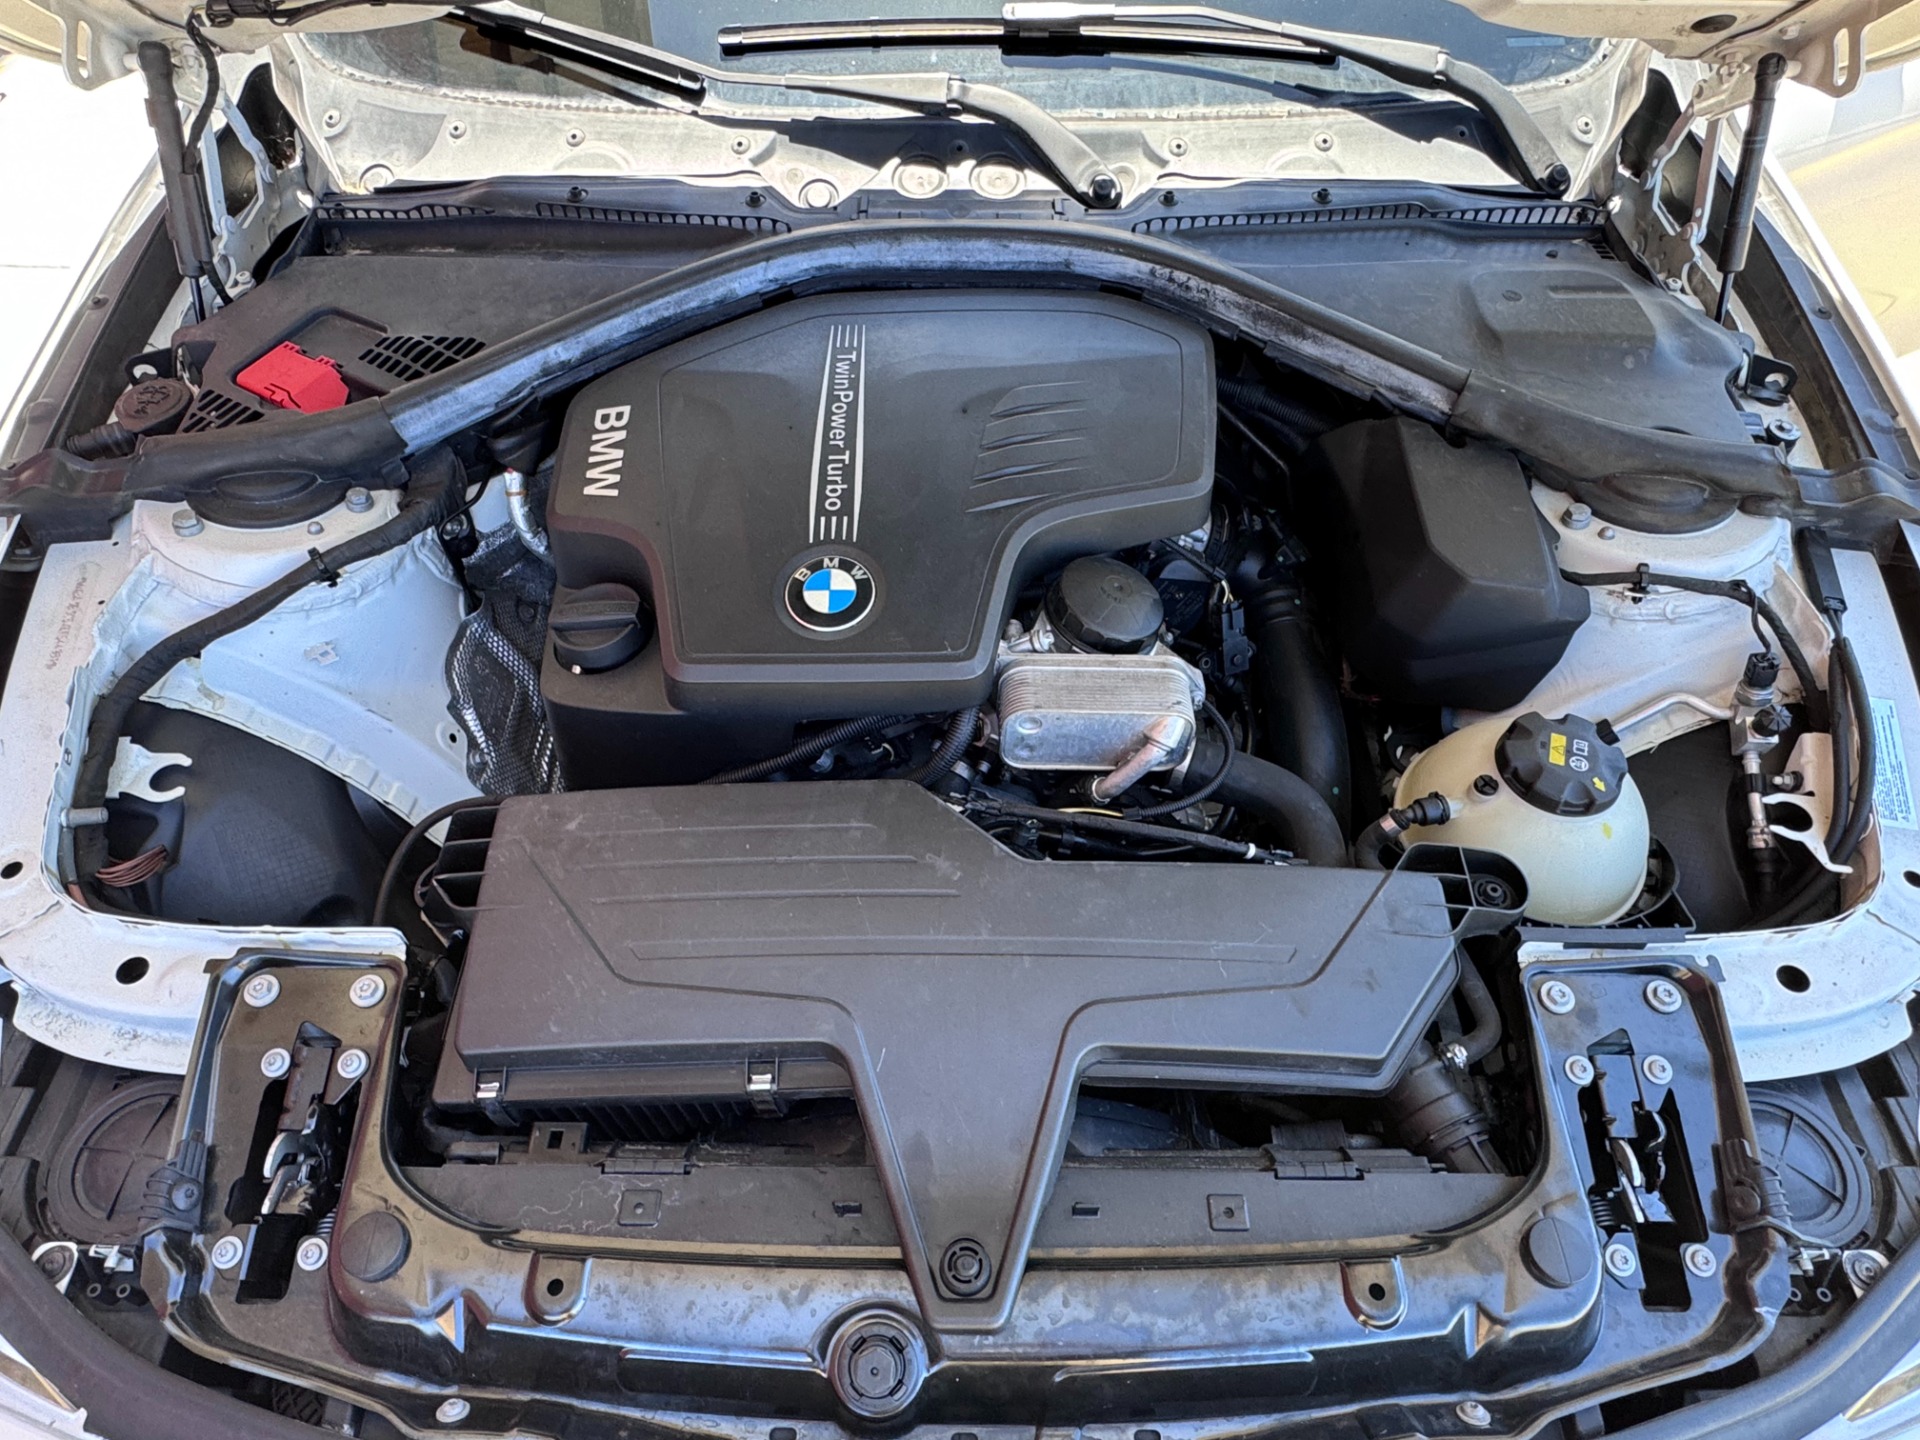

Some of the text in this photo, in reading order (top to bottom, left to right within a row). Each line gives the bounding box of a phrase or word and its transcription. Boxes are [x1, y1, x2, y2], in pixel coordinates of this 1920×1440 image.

[583, 405, 632, 497] BMW
[824, 351, 857, 512] TwinPower Turbo
[794, 557, 868, 582] BMW
